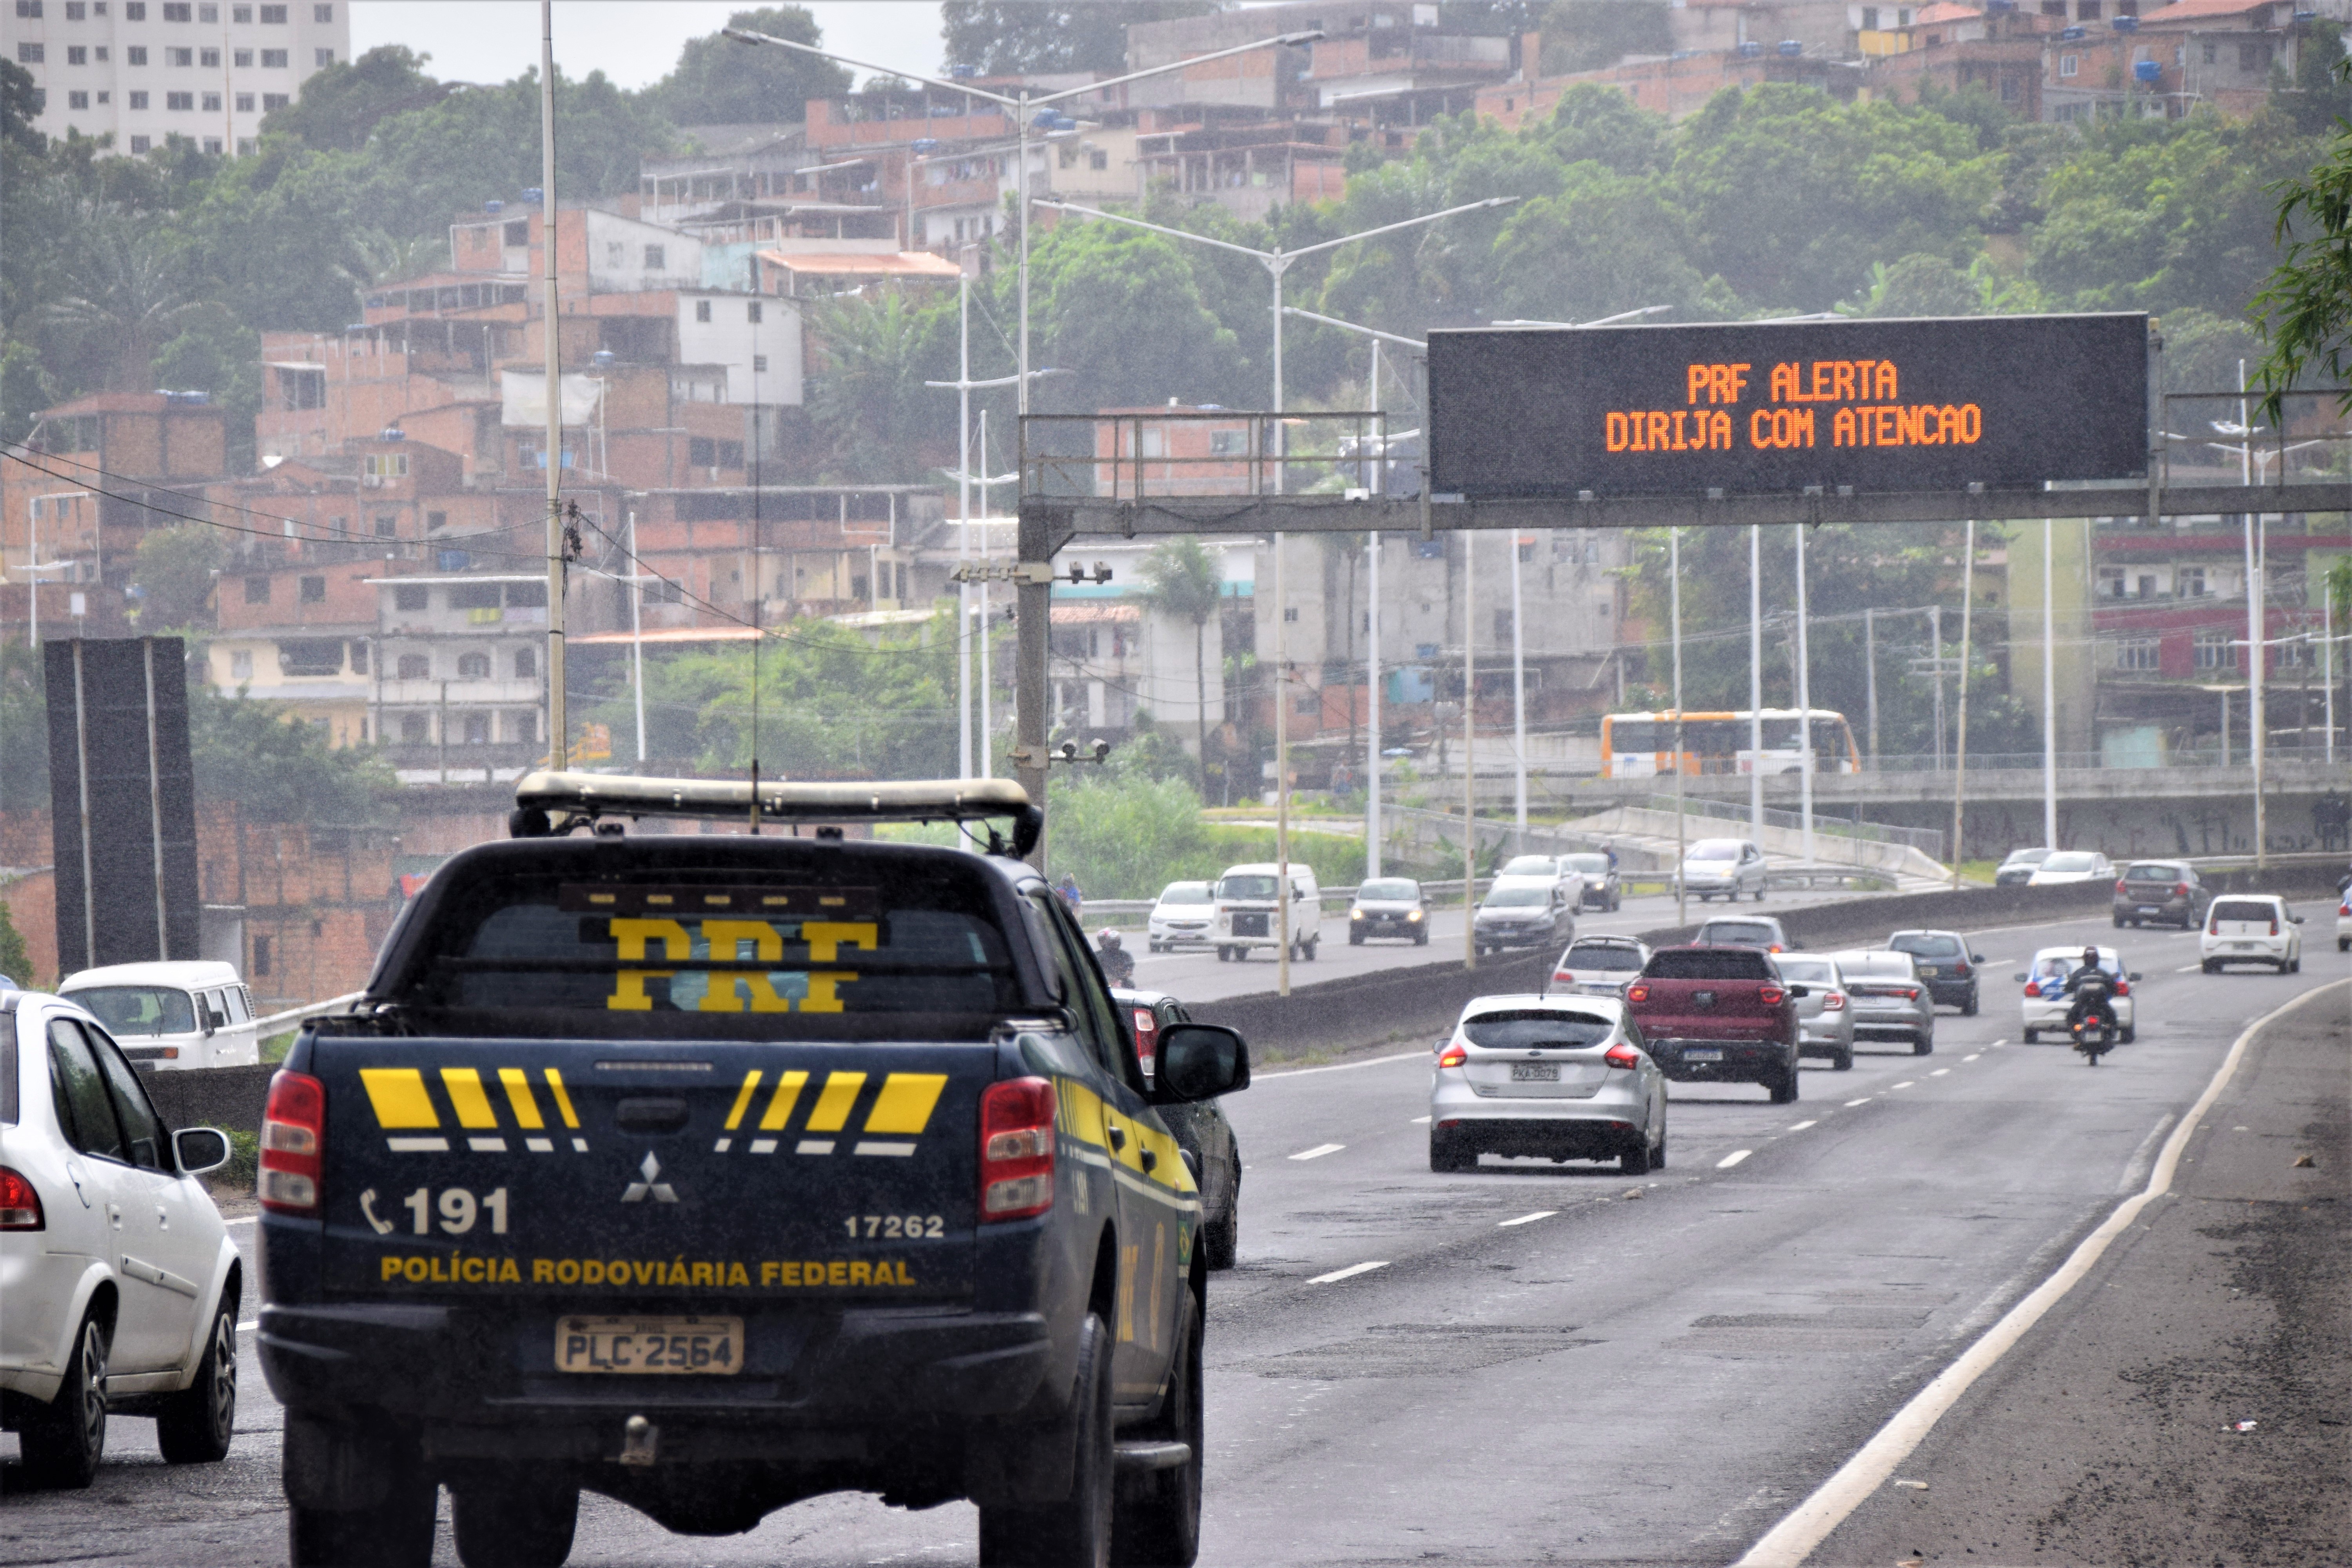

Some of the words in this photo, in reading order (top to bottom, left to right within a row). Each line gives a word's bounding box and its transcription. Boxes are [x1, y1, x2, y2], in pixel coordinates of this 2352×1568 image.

[1688, 363, 1751, 405] PRF
[1770, 359, 1897, 402] ALERTA
[1606, 410, 1731, 452] DIRIJA
[1750, 408, 1815, 449] COM
[1833, 404, 1982, 446] ATENCAO
[607, 918, 878, 1013] PRF
[404, 1188, 508, 1235] 191
[844, 1216, 945, 1239] 17262
[381, 1251, 521, 1283] POLÍCIA
[532, 1254, 750, 1287] RODOVIÁRIA
[760, 1260, 916, 1287] FEDERAL
